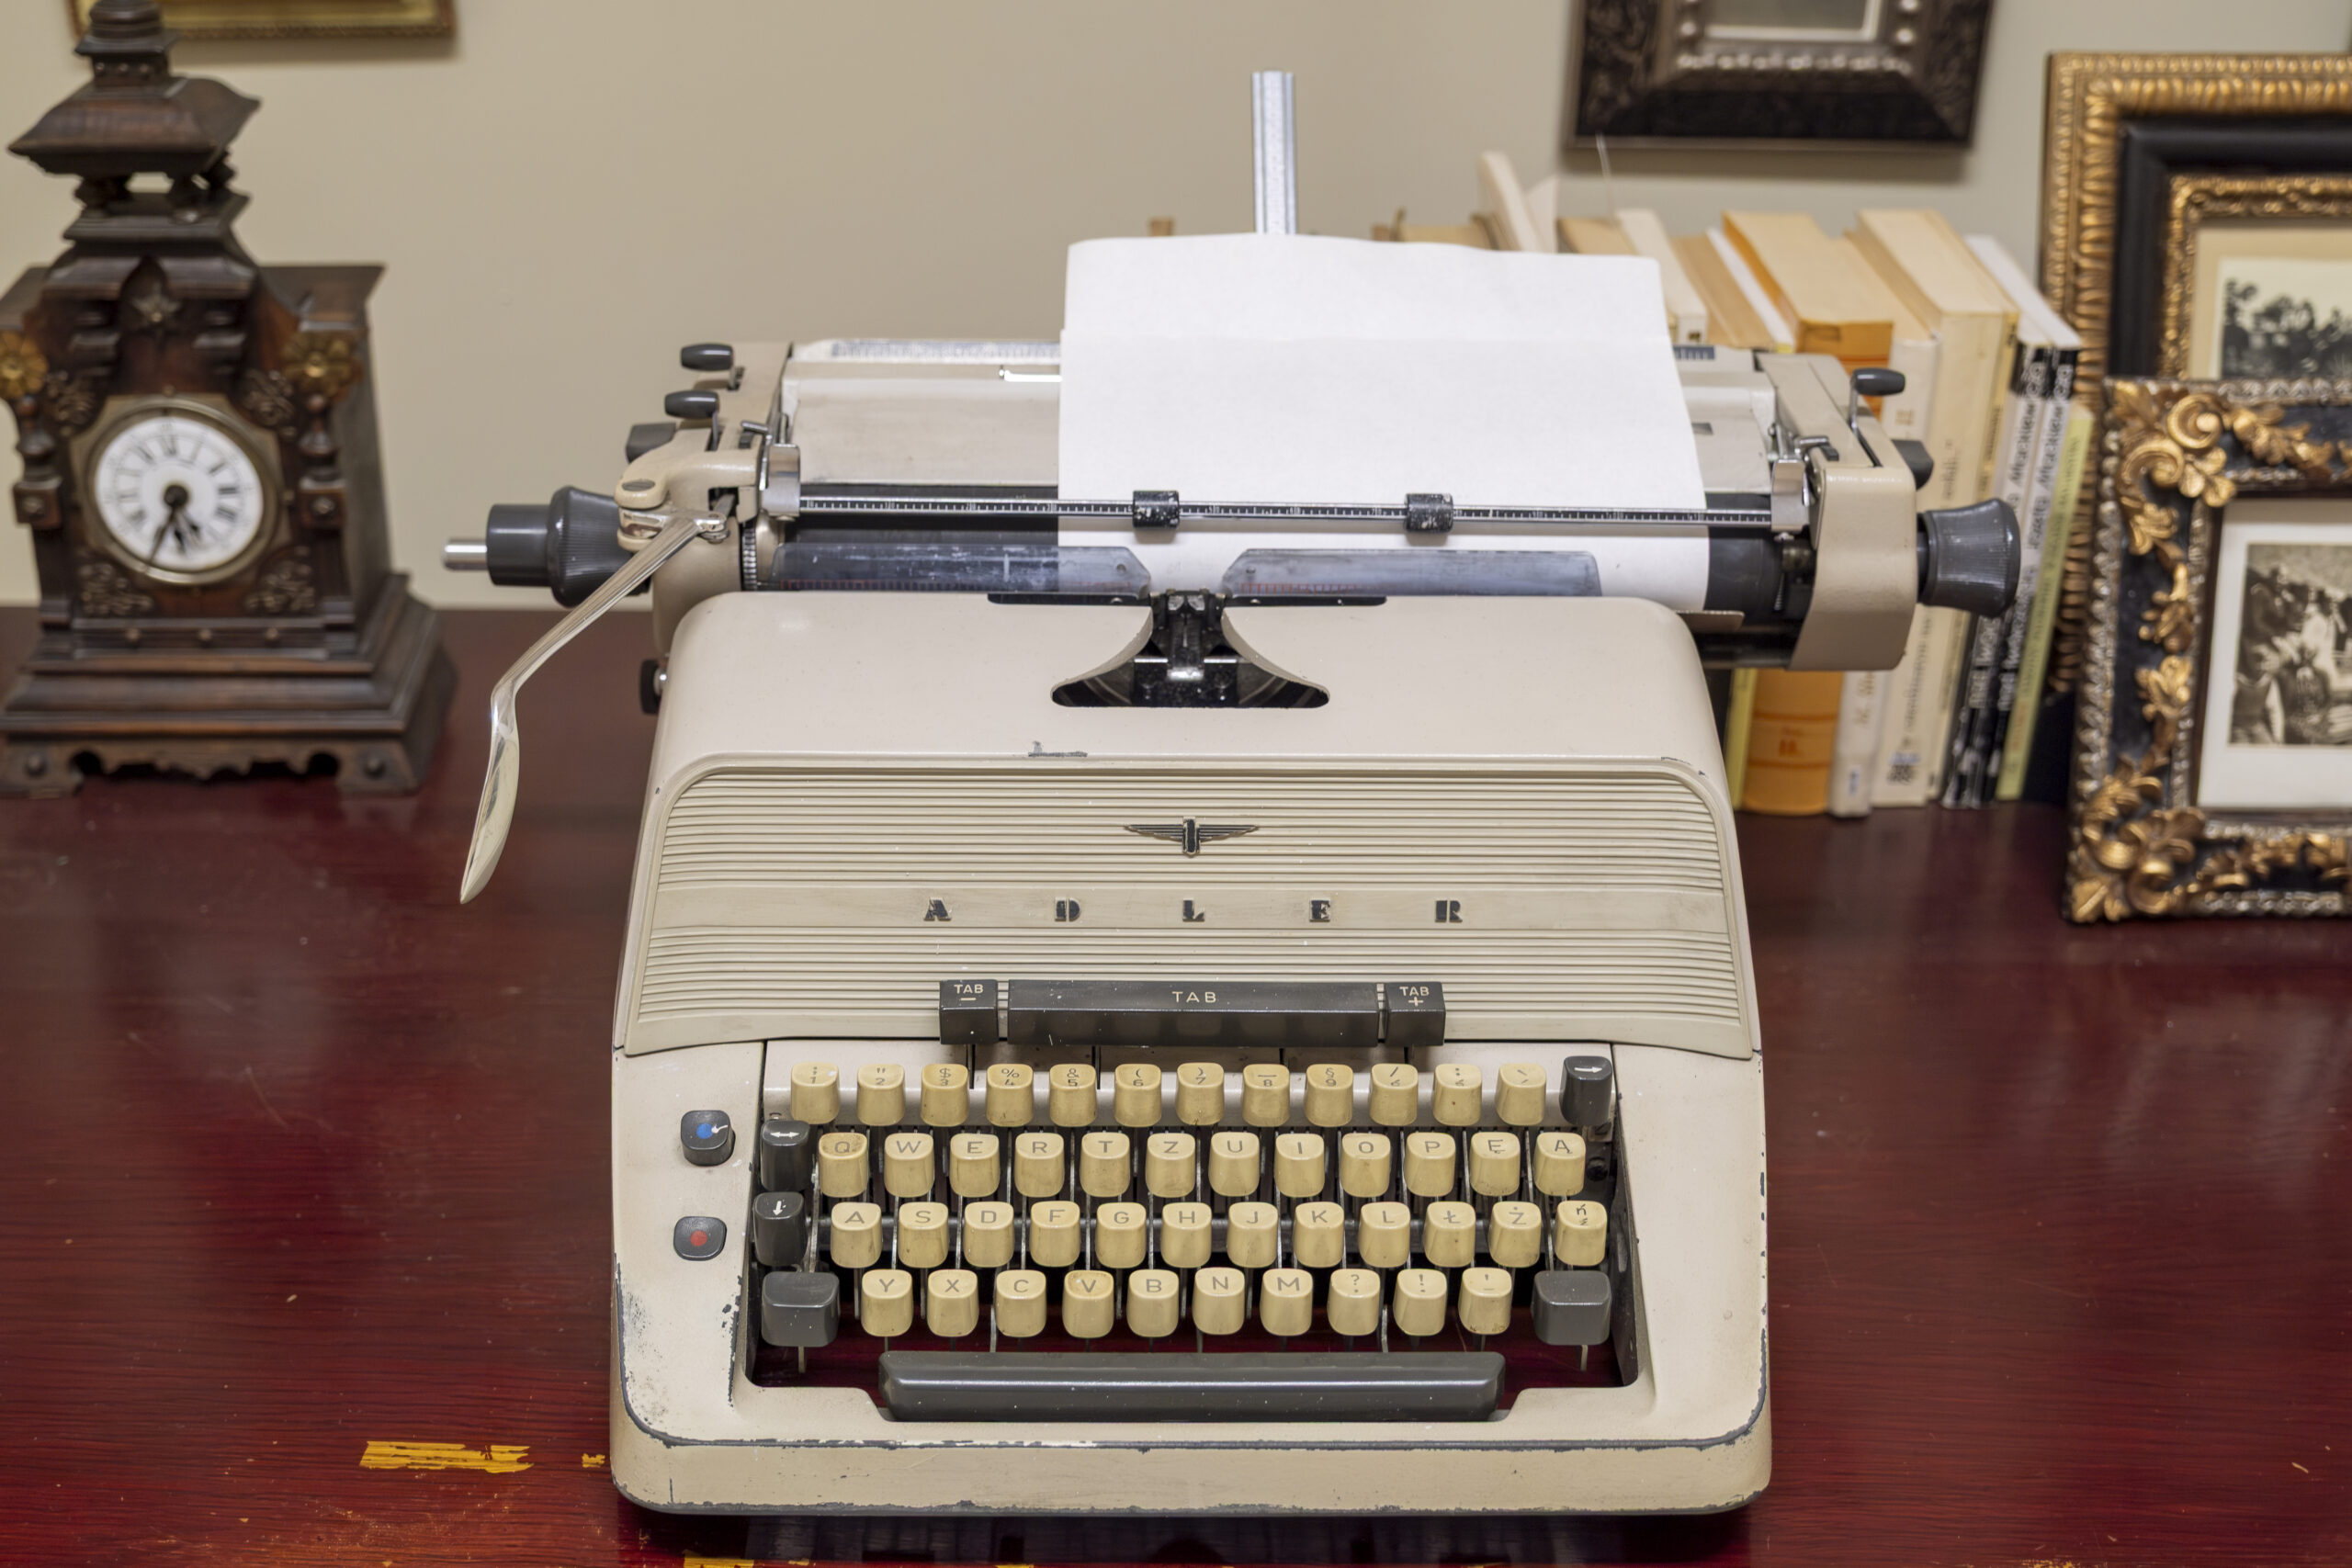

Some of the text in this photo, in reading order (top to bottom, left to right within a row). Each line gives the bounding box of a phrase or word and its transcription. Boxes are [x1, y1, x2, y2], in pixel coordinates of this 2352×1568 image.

[922, 897, 1464, 922] ADLER
[954, 984, 985, 995] TAB
[1399, 987, 1430, 998] TAB
[1171, 991, 1217, 1004] TAB
[939, 1067, 952, 1078] $
[1001, 1067, 1020, 1079] %
[1066, 1067, 1080, 1078] &
[875, 1077, 887, 1086] 2
[939, 1078, 950, 1087] 3
[1067, 1078, 1079, 1087] 5
[1133, 1078, 1145, 1087] 6
[1262, 1078, 1273, 1088] 8
[1325, 1078, 1337, 1087] 9
[834, 1140, 853, 1155] Q
[896, 1140, 922, 1154] W
[967, 1140, 984, 1155] E
[1032, 1141, 1048, 1154] R
[1098, 1140, 1114, 1154] T
[1163, 1141, 1179, 1155] Z
[1227, 1140, 1243, 1154] U
[1358, 1141, 1374, 1155] O
[1424, 1140, 1441, 1154] P
[844, 1211, 865, 1224] A
[915, 1210, 932, 1224] S
[980, 1210, 997, 1224] D
[1048, 1209, 1066, 1223] F
[1114, 1211, 1130, 1224] G
[1178, 1210, 1195, 1224] H
[1246, 1211, 1259, 1224] J
[1311, 1210, 1329, 1224] K
[1382, 1210, 1395, 1224] L
[1442, 1210, 1461, 1224] Ł
[1509, 1206, 1527, 1225] Ż
[878, 1278, 895, 1293] Y
[944, 1279, 960, 1293] X
[1013, 1279, 1029, 1293] C
[1080, 1279, 1097, 1293] V
[1146, 1278, 1162, 1293] B
[1212, 1276, 1229, 1291] N
[1276, 1276, 1300, 1292] M
